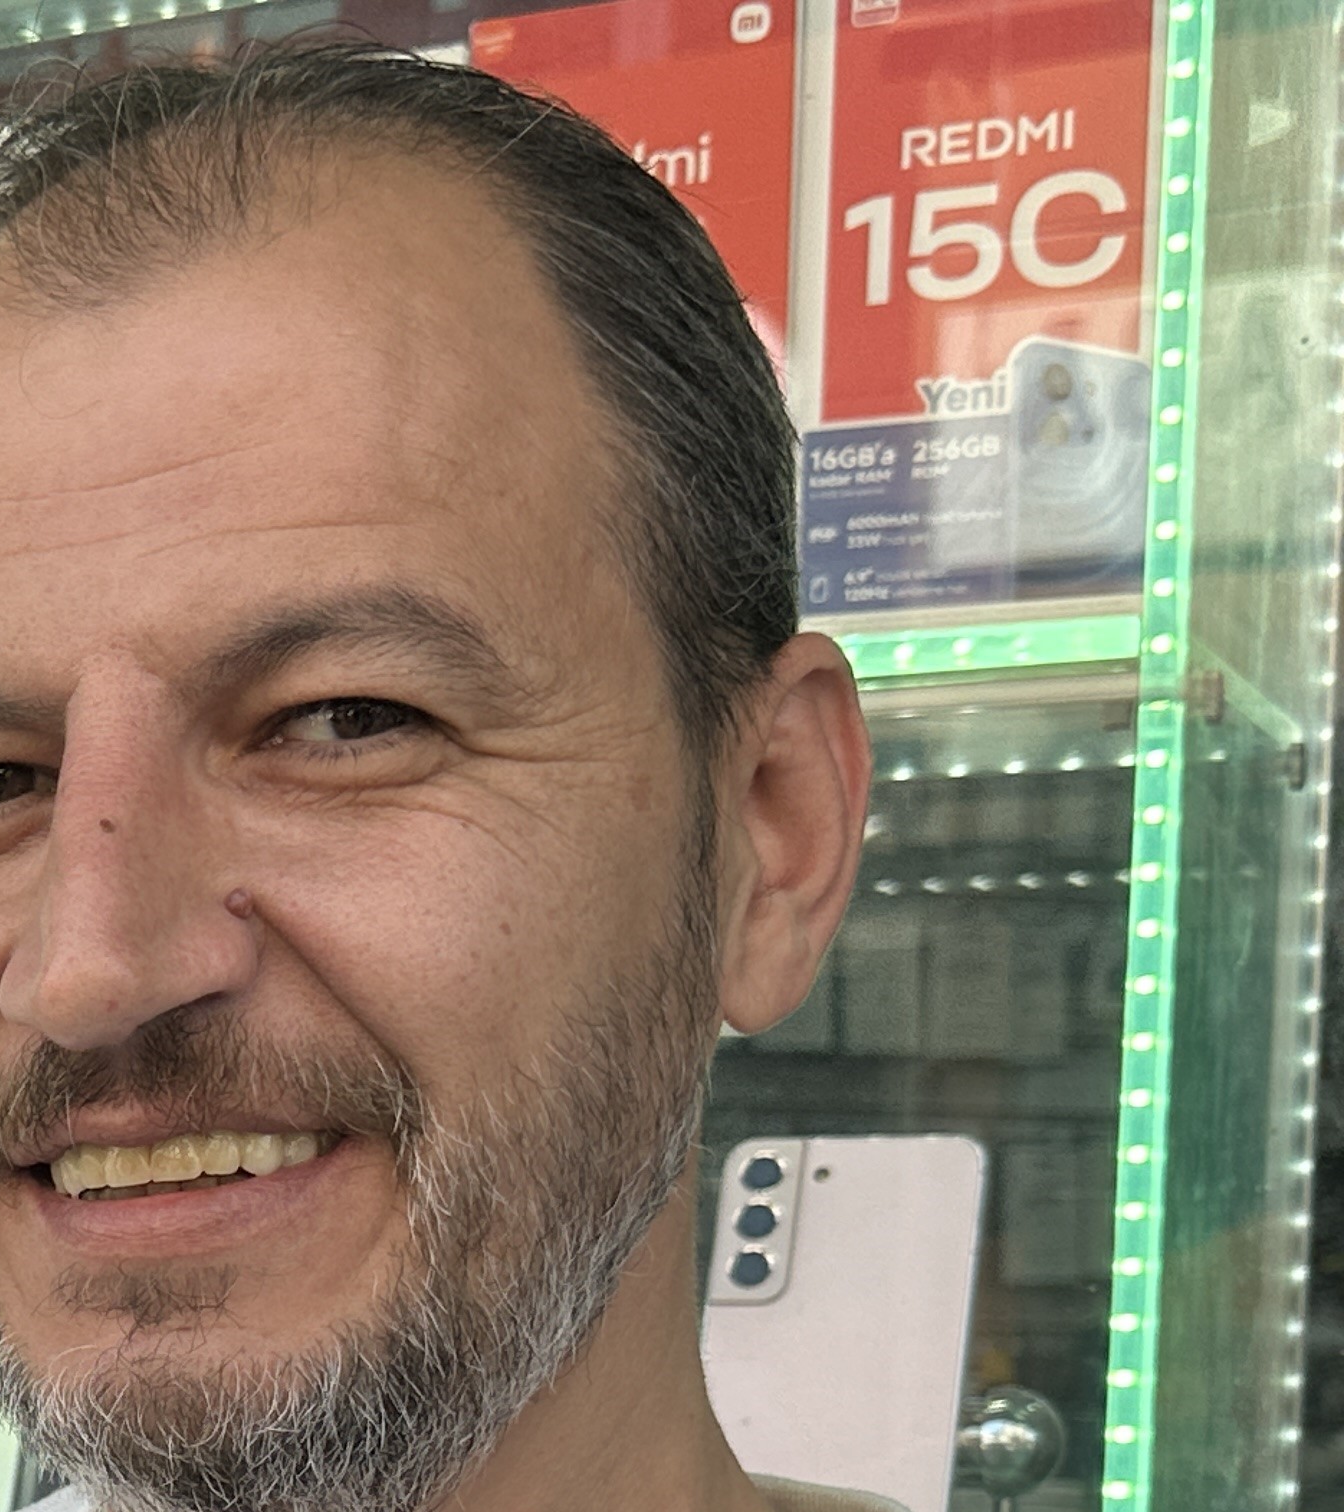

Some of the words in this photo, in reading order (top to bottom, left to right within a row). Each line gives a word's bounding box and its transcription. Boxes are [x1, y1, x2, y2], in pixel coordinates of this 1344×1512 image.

[900, 109, 1075, 171] REDMI
[843, 170, 1128, 307] 15C
[920, 373, 1008, 414] Yeni
[913, 434, 1001, 464] 256GB
